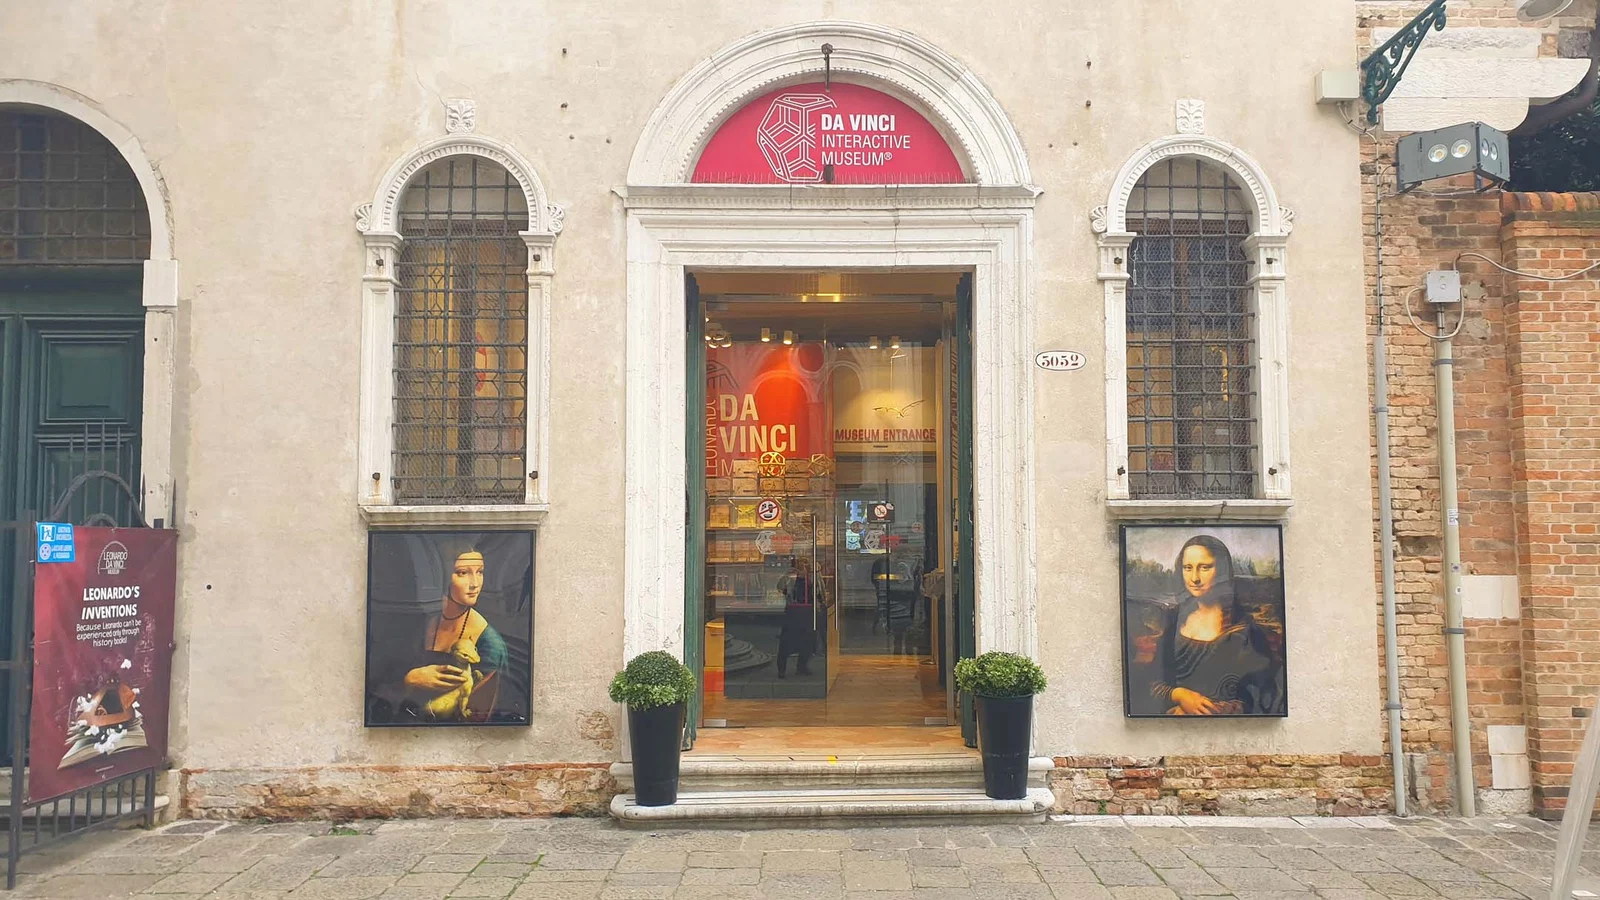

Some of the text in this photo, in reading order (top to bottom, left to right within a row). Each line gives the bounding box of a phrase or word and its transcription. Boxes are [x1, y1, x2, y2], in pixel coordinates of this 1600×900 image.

[821, 113, 895, 131] DA VINCI
[821, 134, 911, 149] INTERACTIVE
[719, 393, 759, 422] DA
[719, 424, 797, 453] VINCI
[835, 428, 936, 441] MUSEUM ENTRANCE
[103, 551, 128, 561] LEONARDO
[83, 586, 140, 601] LEONARDO'S
[81, 604, 137, 620] INVENTIONS
[76, 619, 142, 632] Because Leonardo can't be
[76, 627, 140, 641] experienced only through
[92, 639, 113, 648] history
